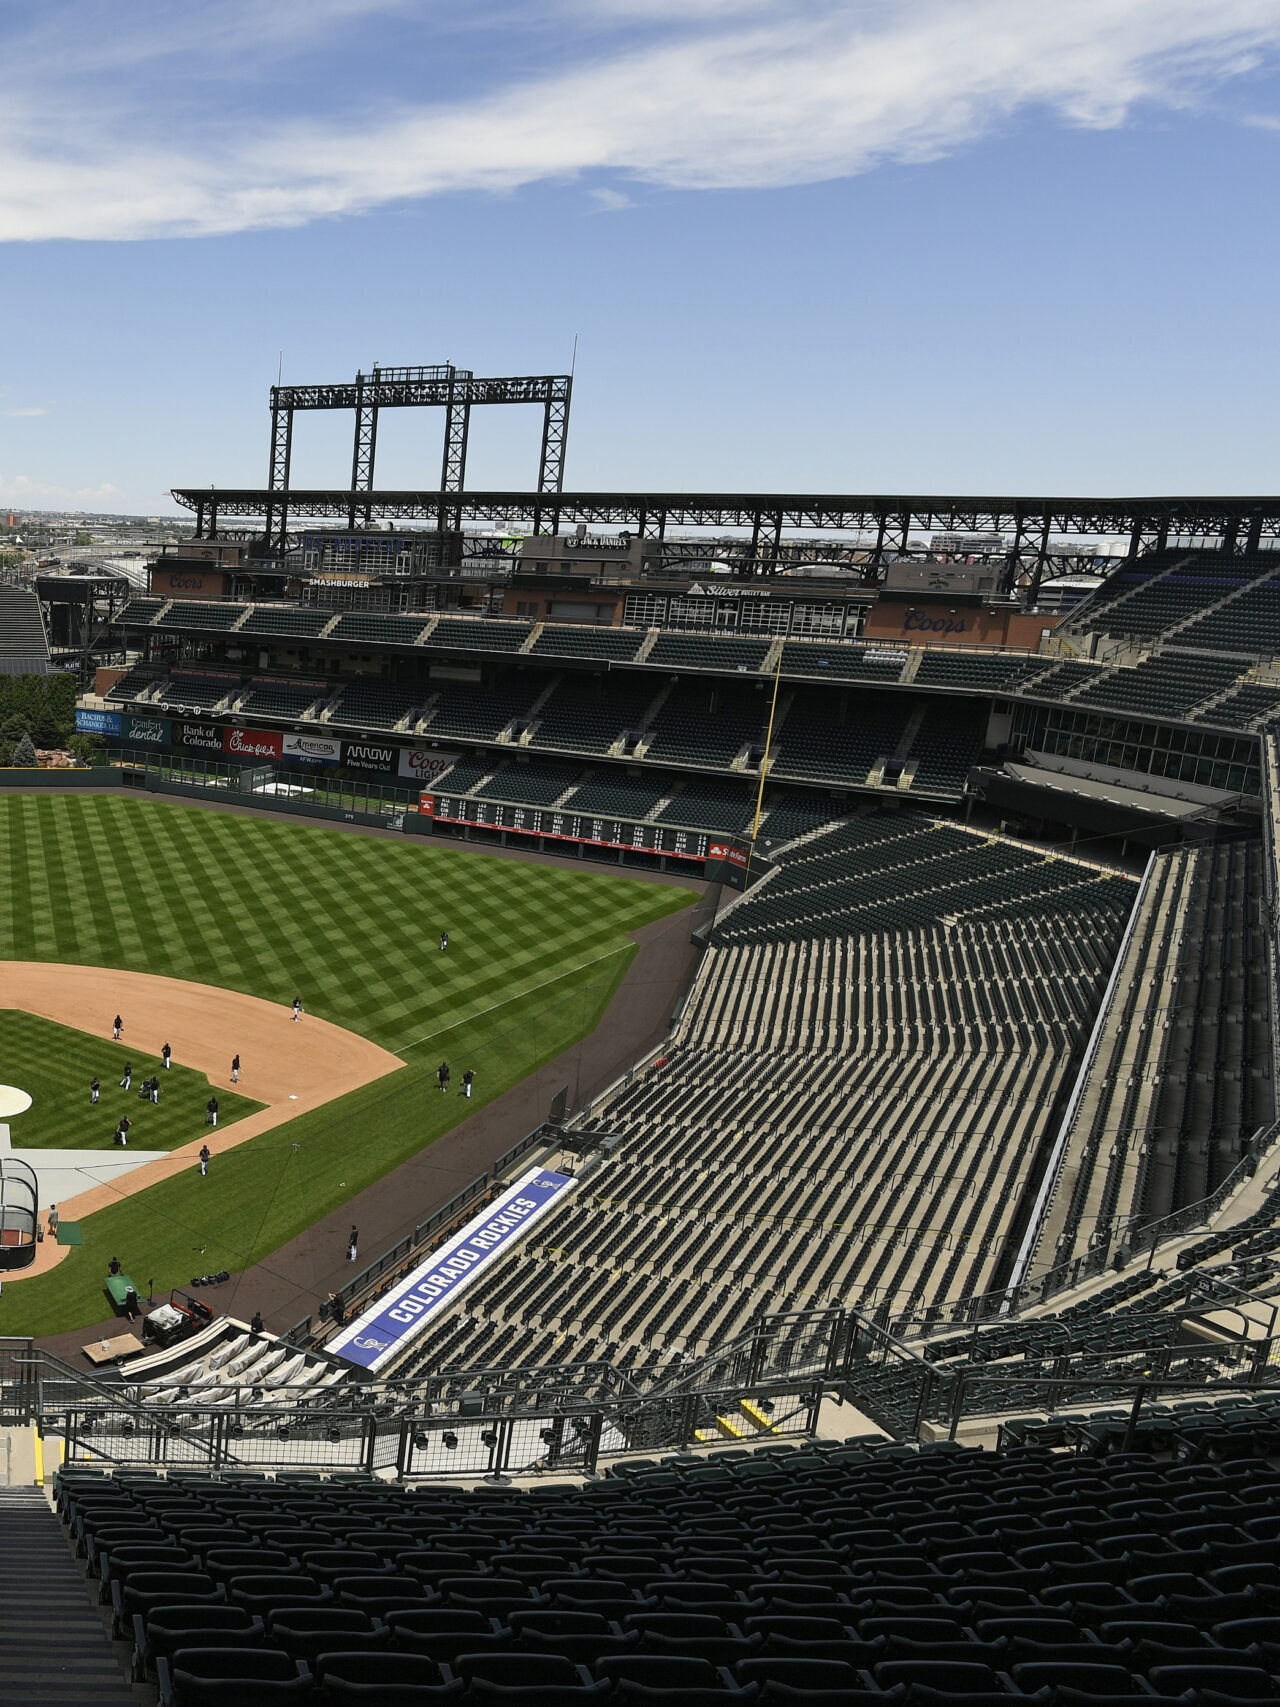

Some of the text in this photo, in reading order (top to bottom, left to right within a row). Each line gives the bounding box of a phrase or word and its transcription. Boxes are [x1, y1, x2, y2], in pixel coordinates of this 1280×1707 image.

[169, 574, 203, 589] Coors
[309, 579, 369, 588] SMASHBURGER
[706, 585, 740, 596] Silver
[904, 610, 966, 633] Coors
[81, 712, 106, 721] BACHUS
[132, 718, 161, 730] Comfort
[129, 727, 164, 742] dental
[183, 725, 216, 738] Bank of
[183, 735, 222, 749] Colorado
[347, 759, 391, 772] Five Years Out
[408, 751, 448, 772] Coor
[416, 769, 439, 779] LIGH
[388, 1197, 537, 1324] COLORADO ROCKIES
